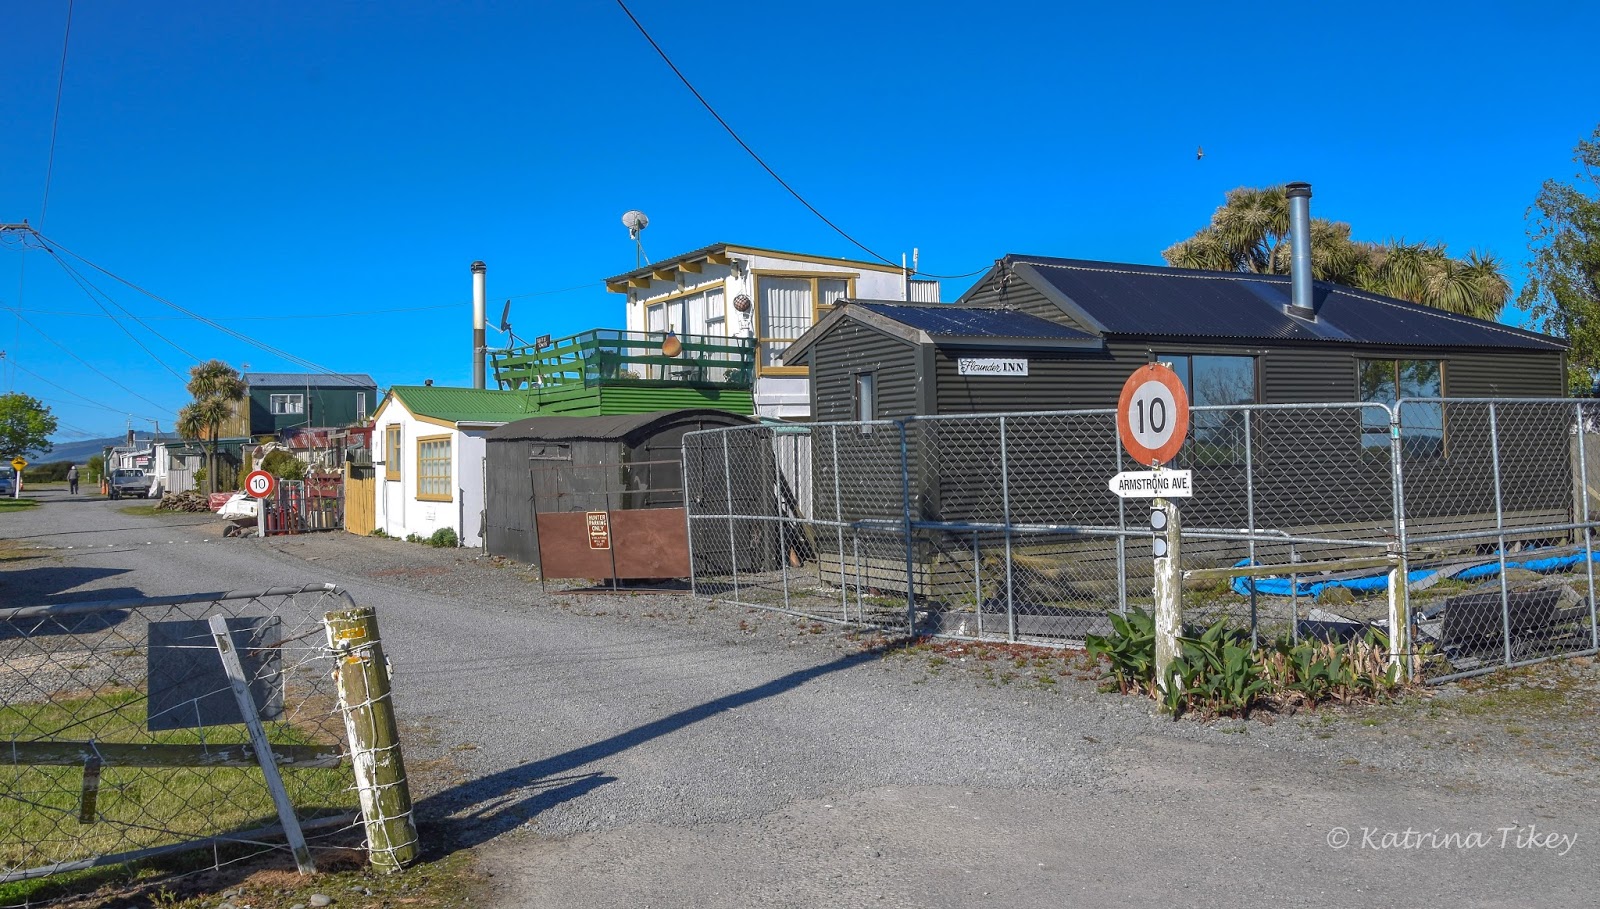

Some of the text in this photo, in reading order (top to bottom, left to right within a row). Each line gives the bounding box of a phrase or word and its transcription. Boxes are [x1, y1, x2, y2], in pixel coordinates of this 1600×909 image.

[961, 360, 1024, 373] Flounder INN
[1137, 397, 1166, 433] 10
[253, 479, 265, 489] 10
[1119, 477, 1190, 490] ARMSTRONG AVE.
